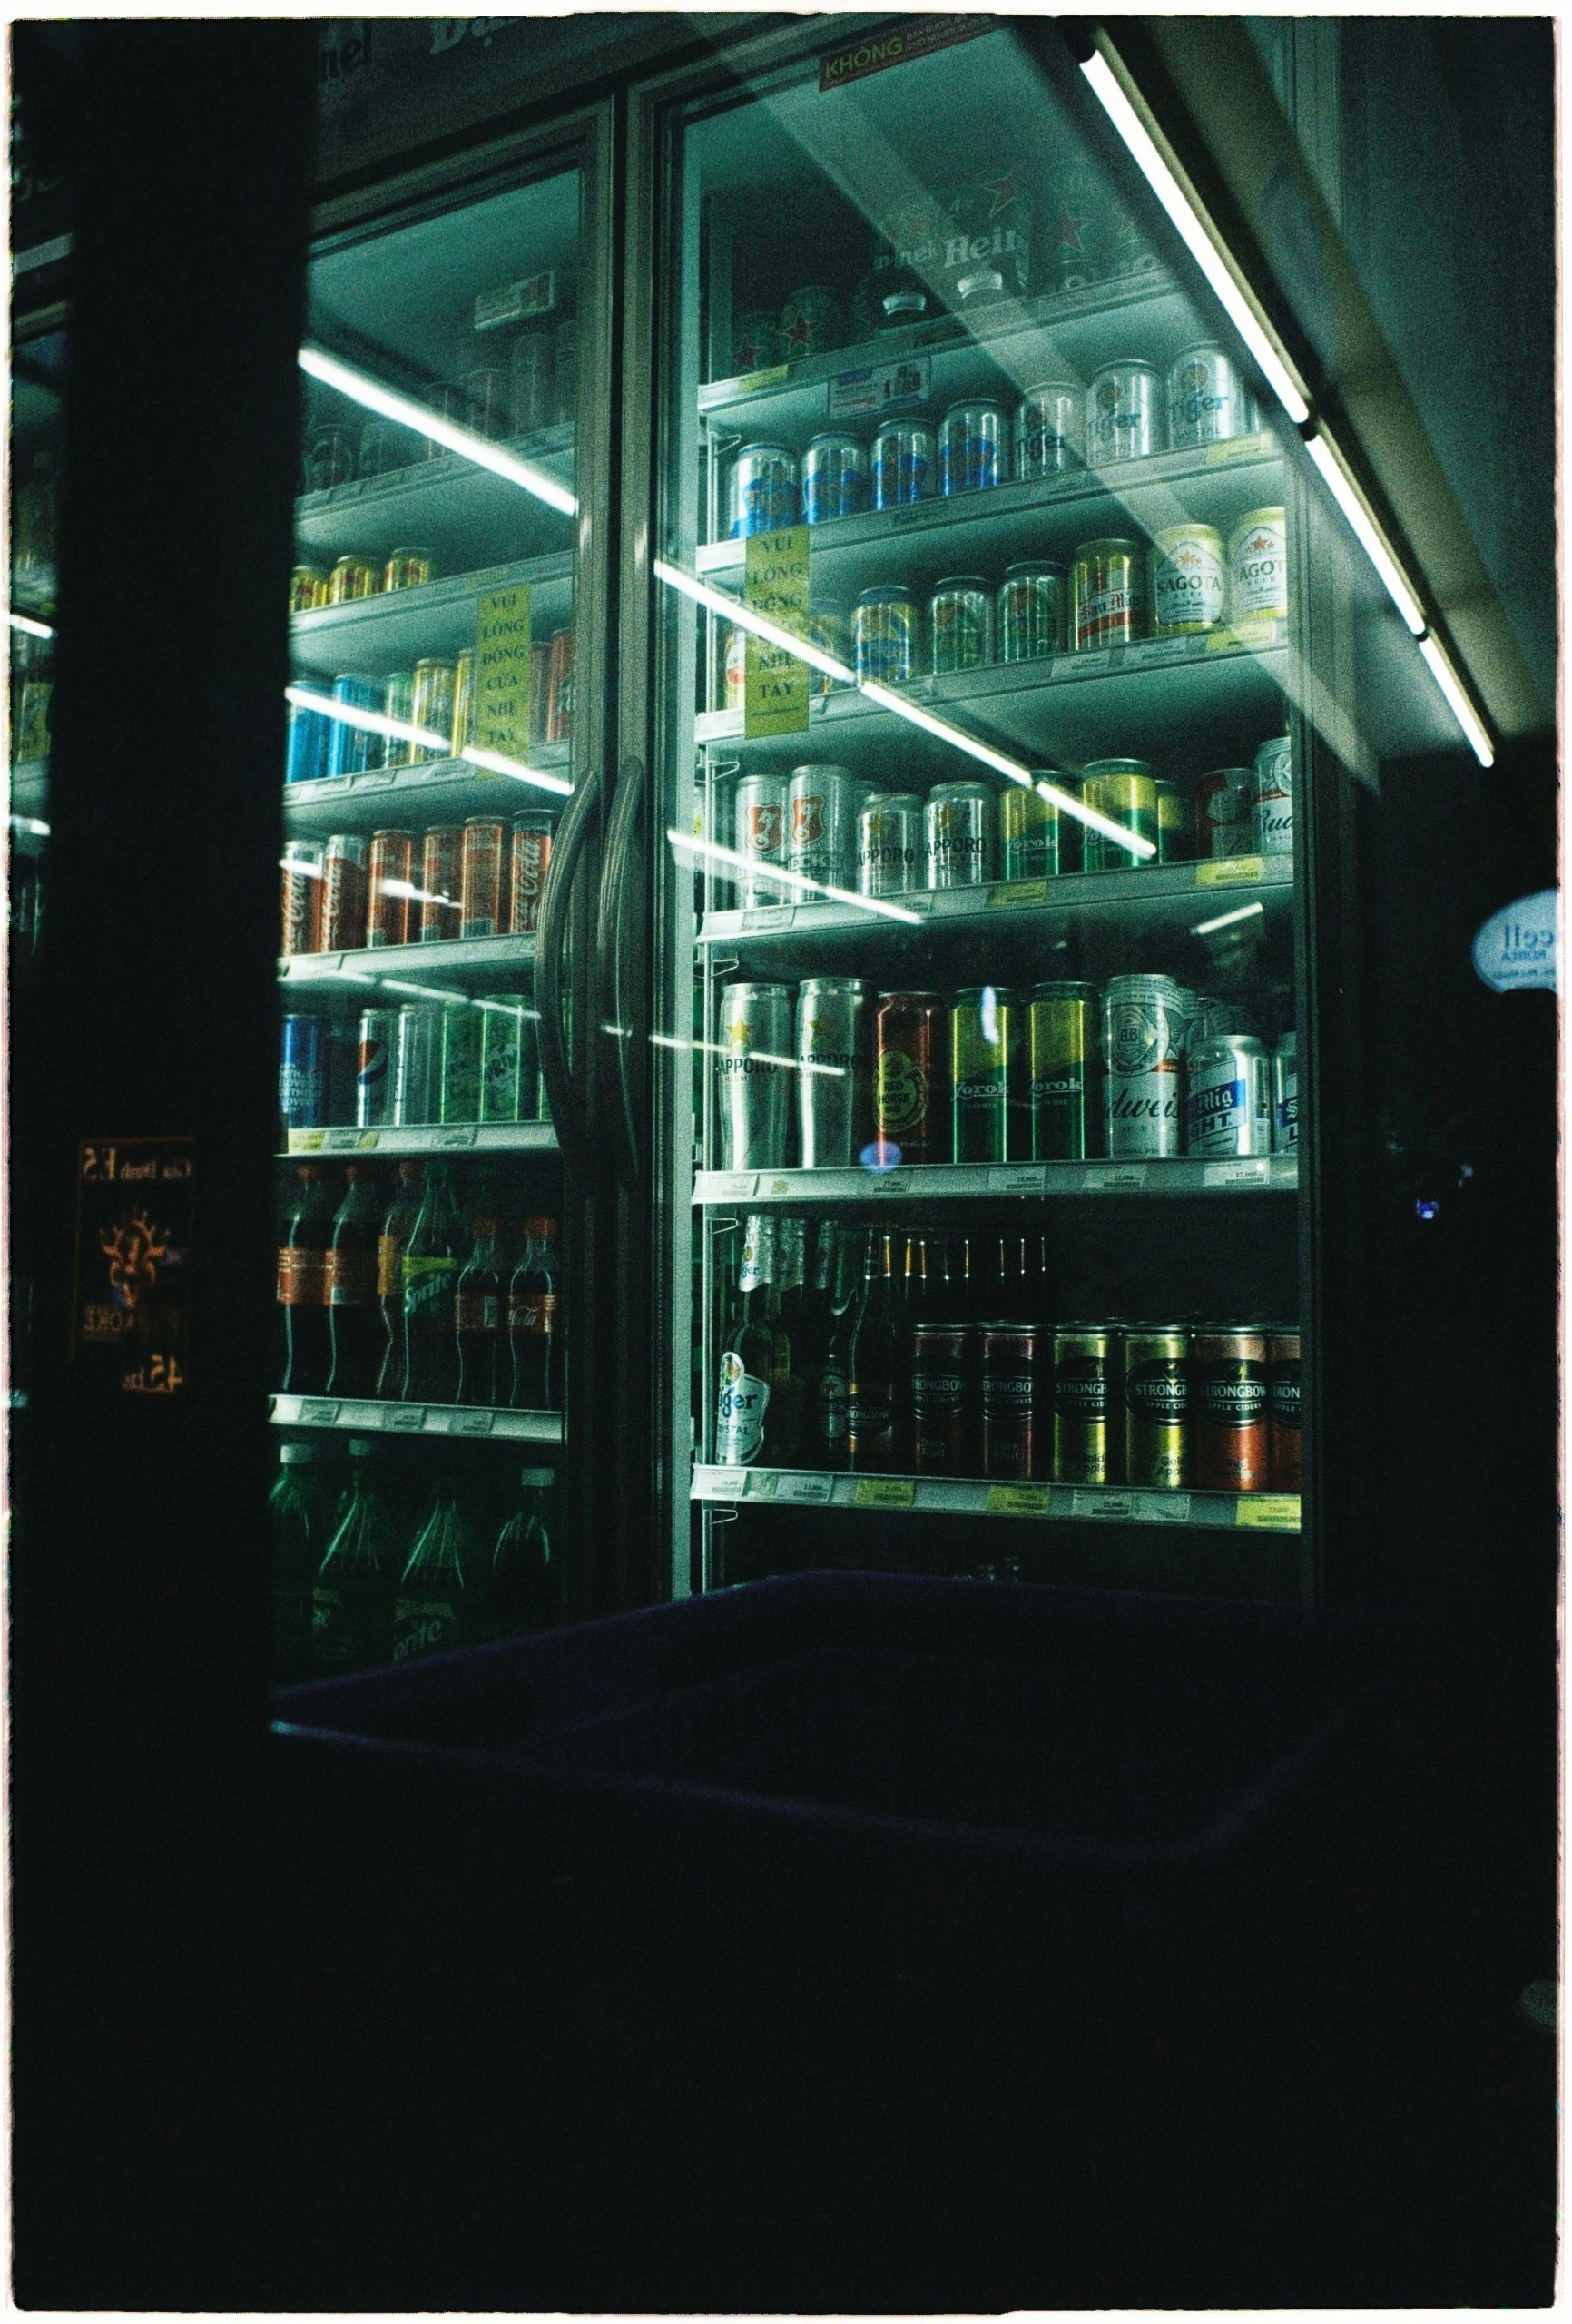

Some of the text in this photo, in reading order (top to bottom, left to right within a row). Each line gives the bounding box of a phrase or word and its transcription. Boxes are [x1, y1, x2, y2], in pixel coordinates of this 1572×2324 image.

[761, 535, 793, 553] VUI
[1157, 575, 1222, 597] SAGOTA
[491, 594, 517, 609] VUI
[761, 682, 794, 699] TAY
[921, 836, 987, 856] APPORO
[715, 1057, 778, 1075] APPORO
[405, 1272, 451, 1313] Sprite
